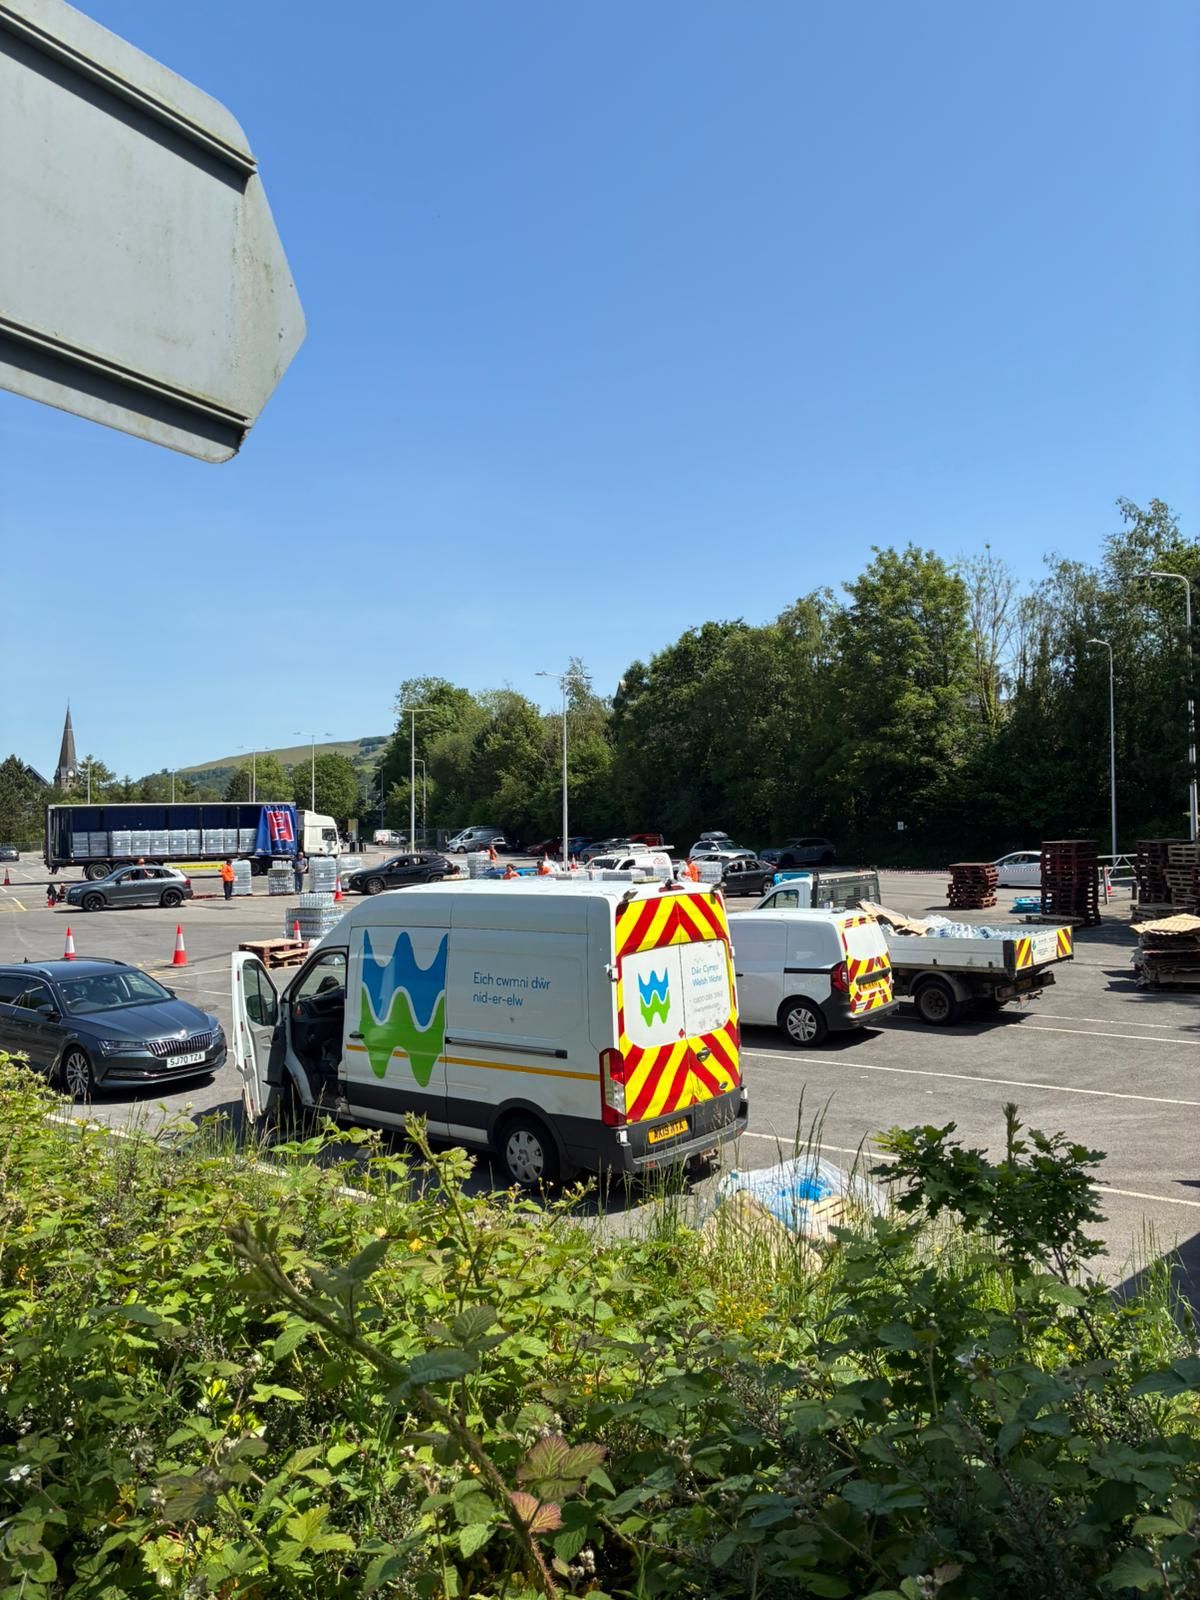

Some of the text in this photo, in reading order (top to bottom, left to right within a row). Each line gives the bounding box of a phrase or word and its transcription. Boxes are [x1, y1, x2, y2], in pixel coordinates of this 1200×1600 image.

[473, 971, 494, 985] Eich
[495, 976, 529, 988] cwmni
[473, 992, 524, 1007] nid-er-elw
[170, 1055, 188, 1066] SJ70
